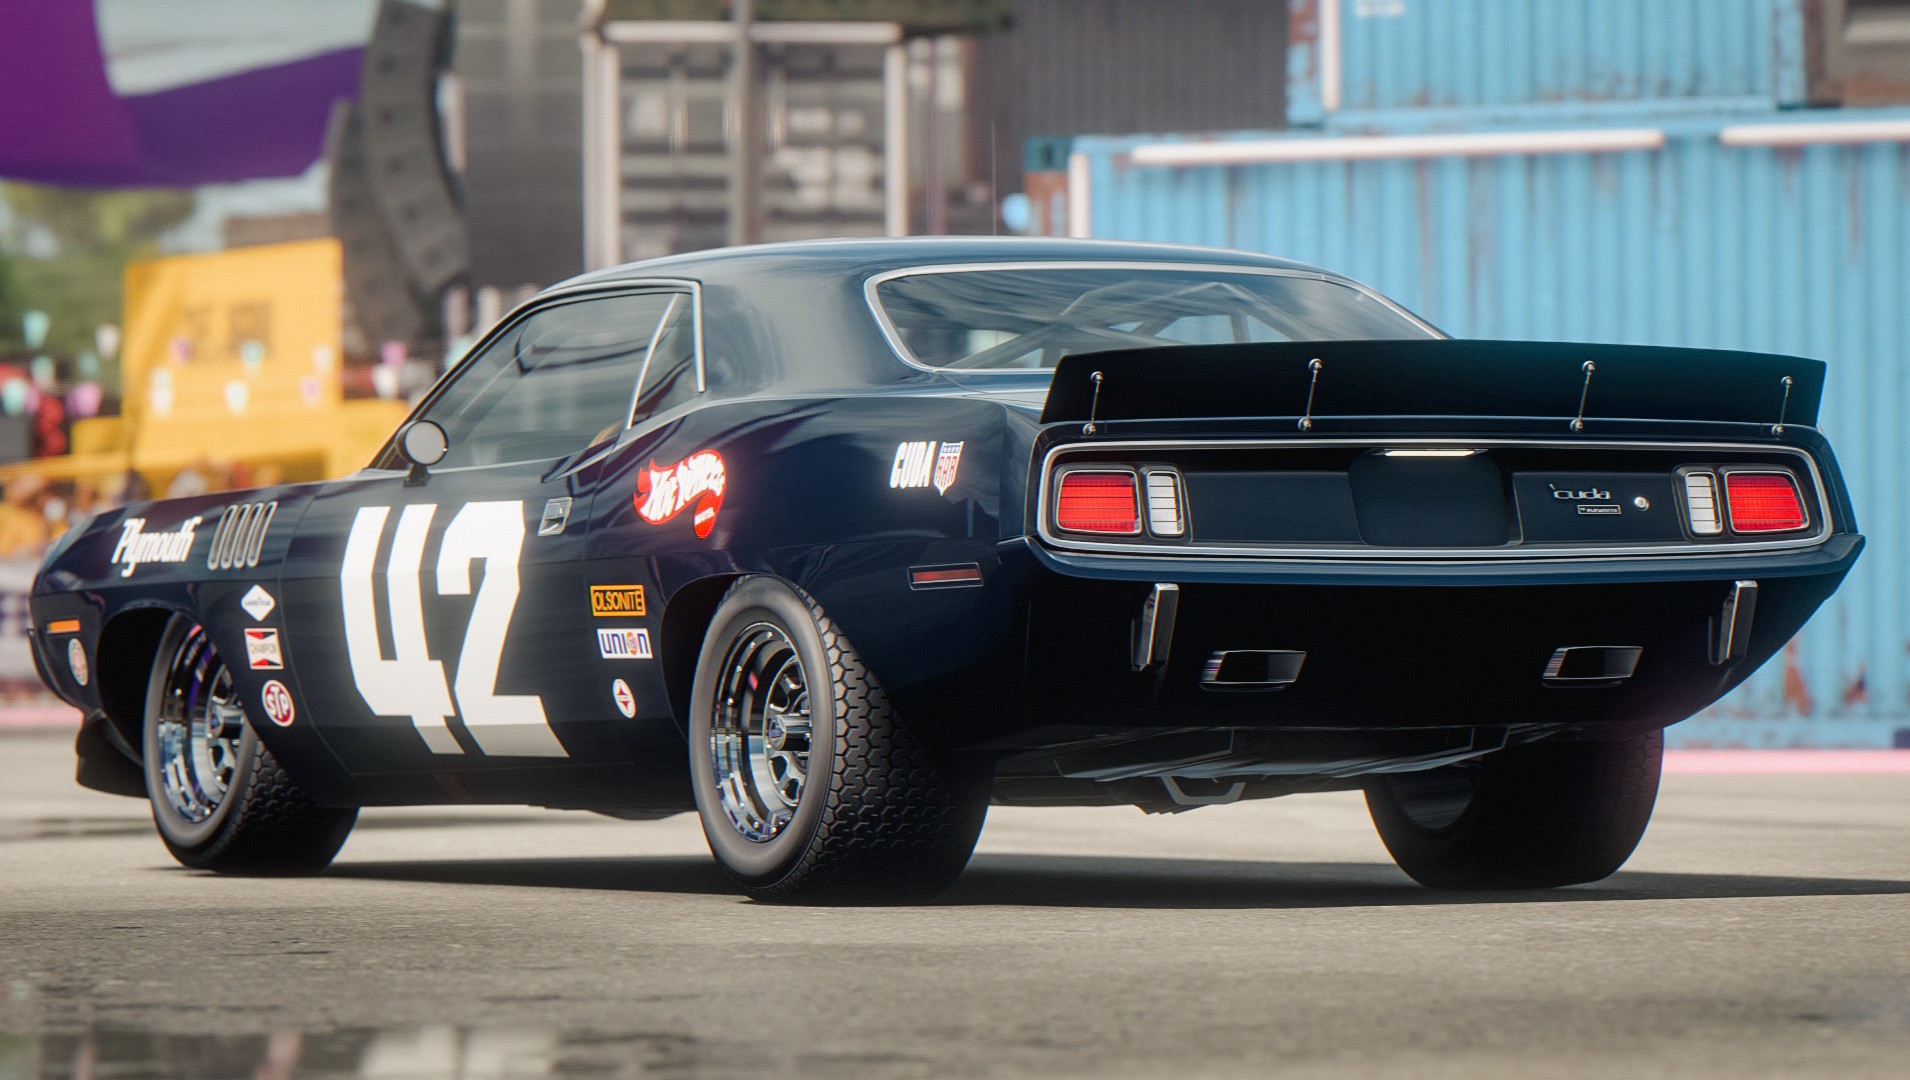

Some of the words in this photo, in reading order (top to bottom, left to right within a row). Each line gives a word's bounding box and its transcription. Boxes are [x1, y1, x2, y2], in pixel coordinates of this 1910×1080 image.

[889, 441, 937, 489] CUDA
[640, 469, 678, 521] Hot
[111, 516, 203, 578] Plymouth
[594, 591, 643, 611] OLSONITE
[340, 500, 570, 757] 42
[265, 685, 291, 720] STP
